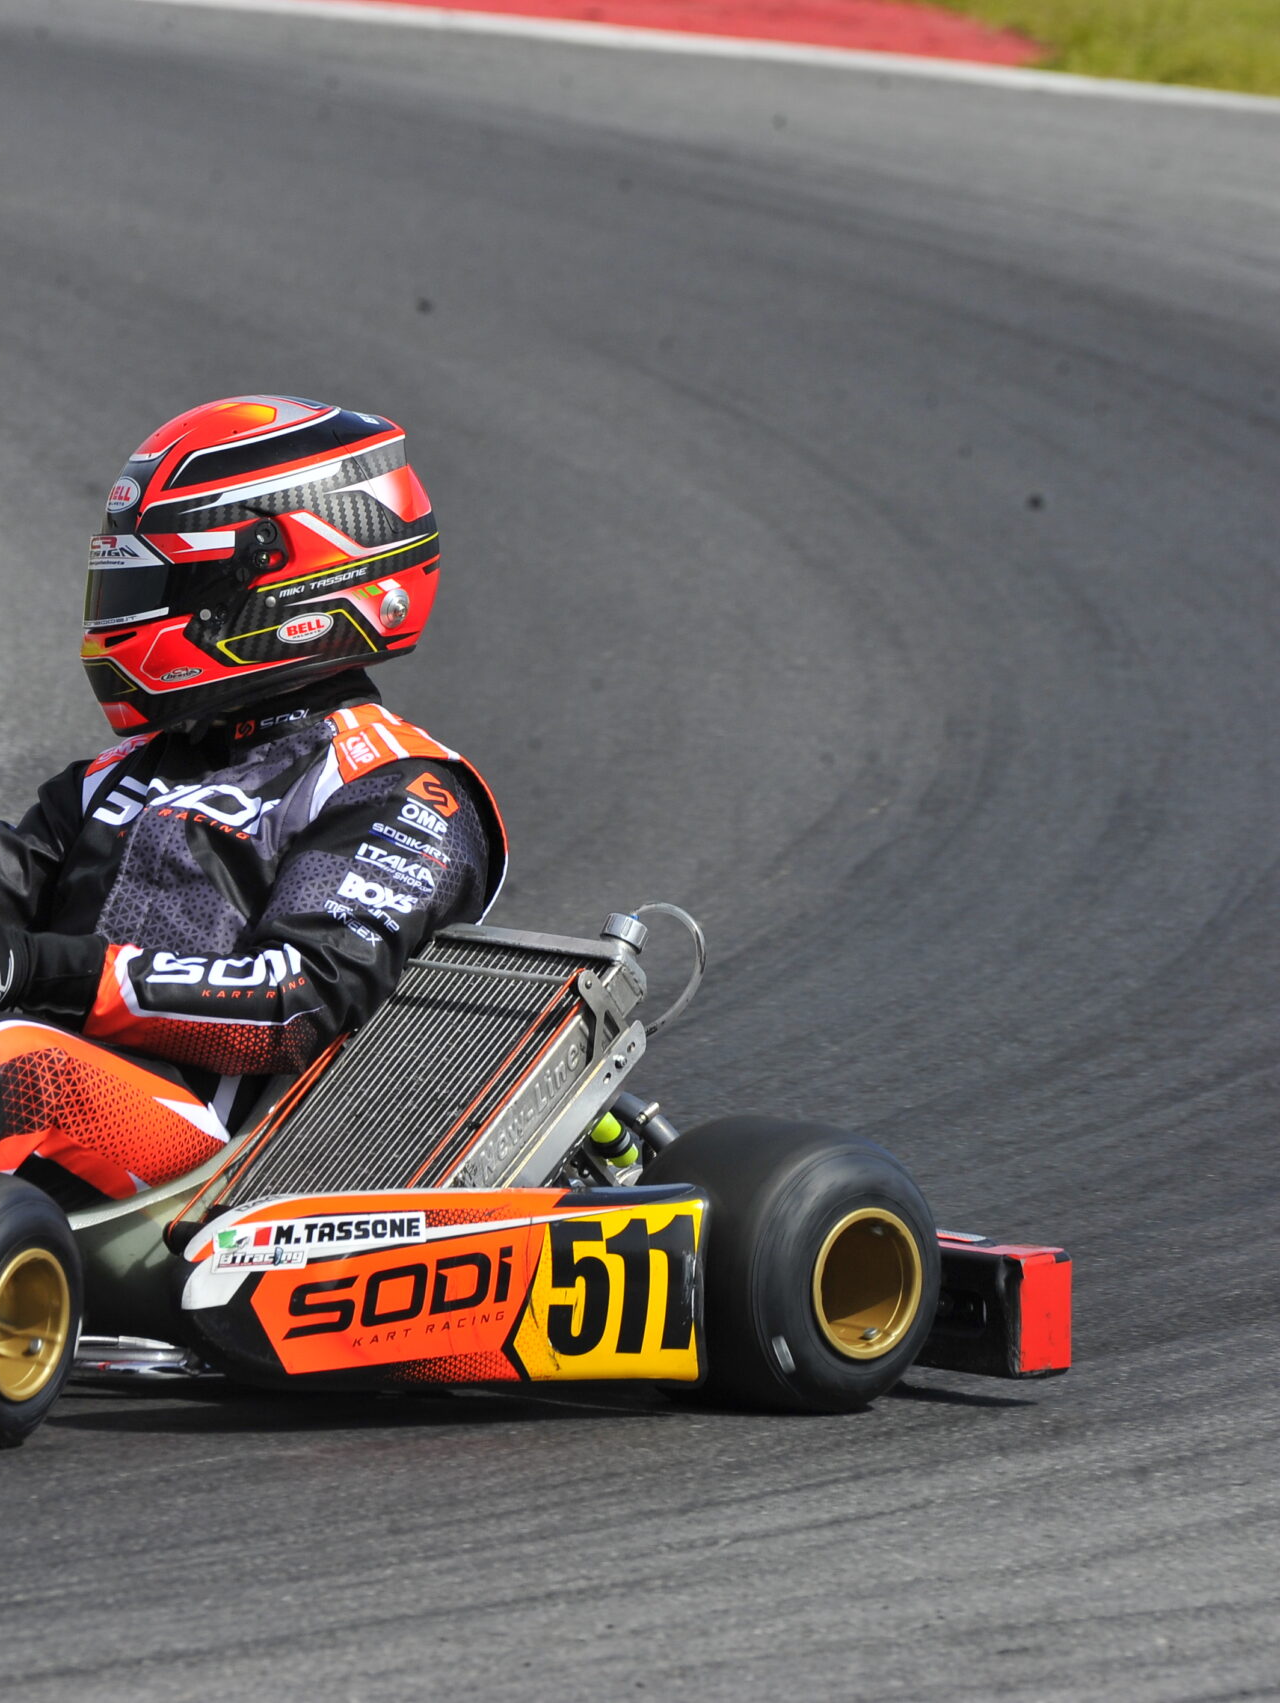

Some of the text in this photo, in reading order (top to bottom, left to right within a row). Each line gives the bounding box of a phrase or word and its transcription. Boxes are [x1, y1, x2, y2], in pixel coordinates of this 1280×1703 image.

[278, 566, 368, 598] MIKI TASSONE
[286, 618, 325, 637] BELL
[157, 808, 250, 840] RACING
[401, 803, 448, 835] OMP
[371, 822, 451, 864] SODIKART
[201, 977, 307, 999] KART RING
[546, 1213, 697, 1357] 511
[352, 1310, 506, 1348] KART RACING
